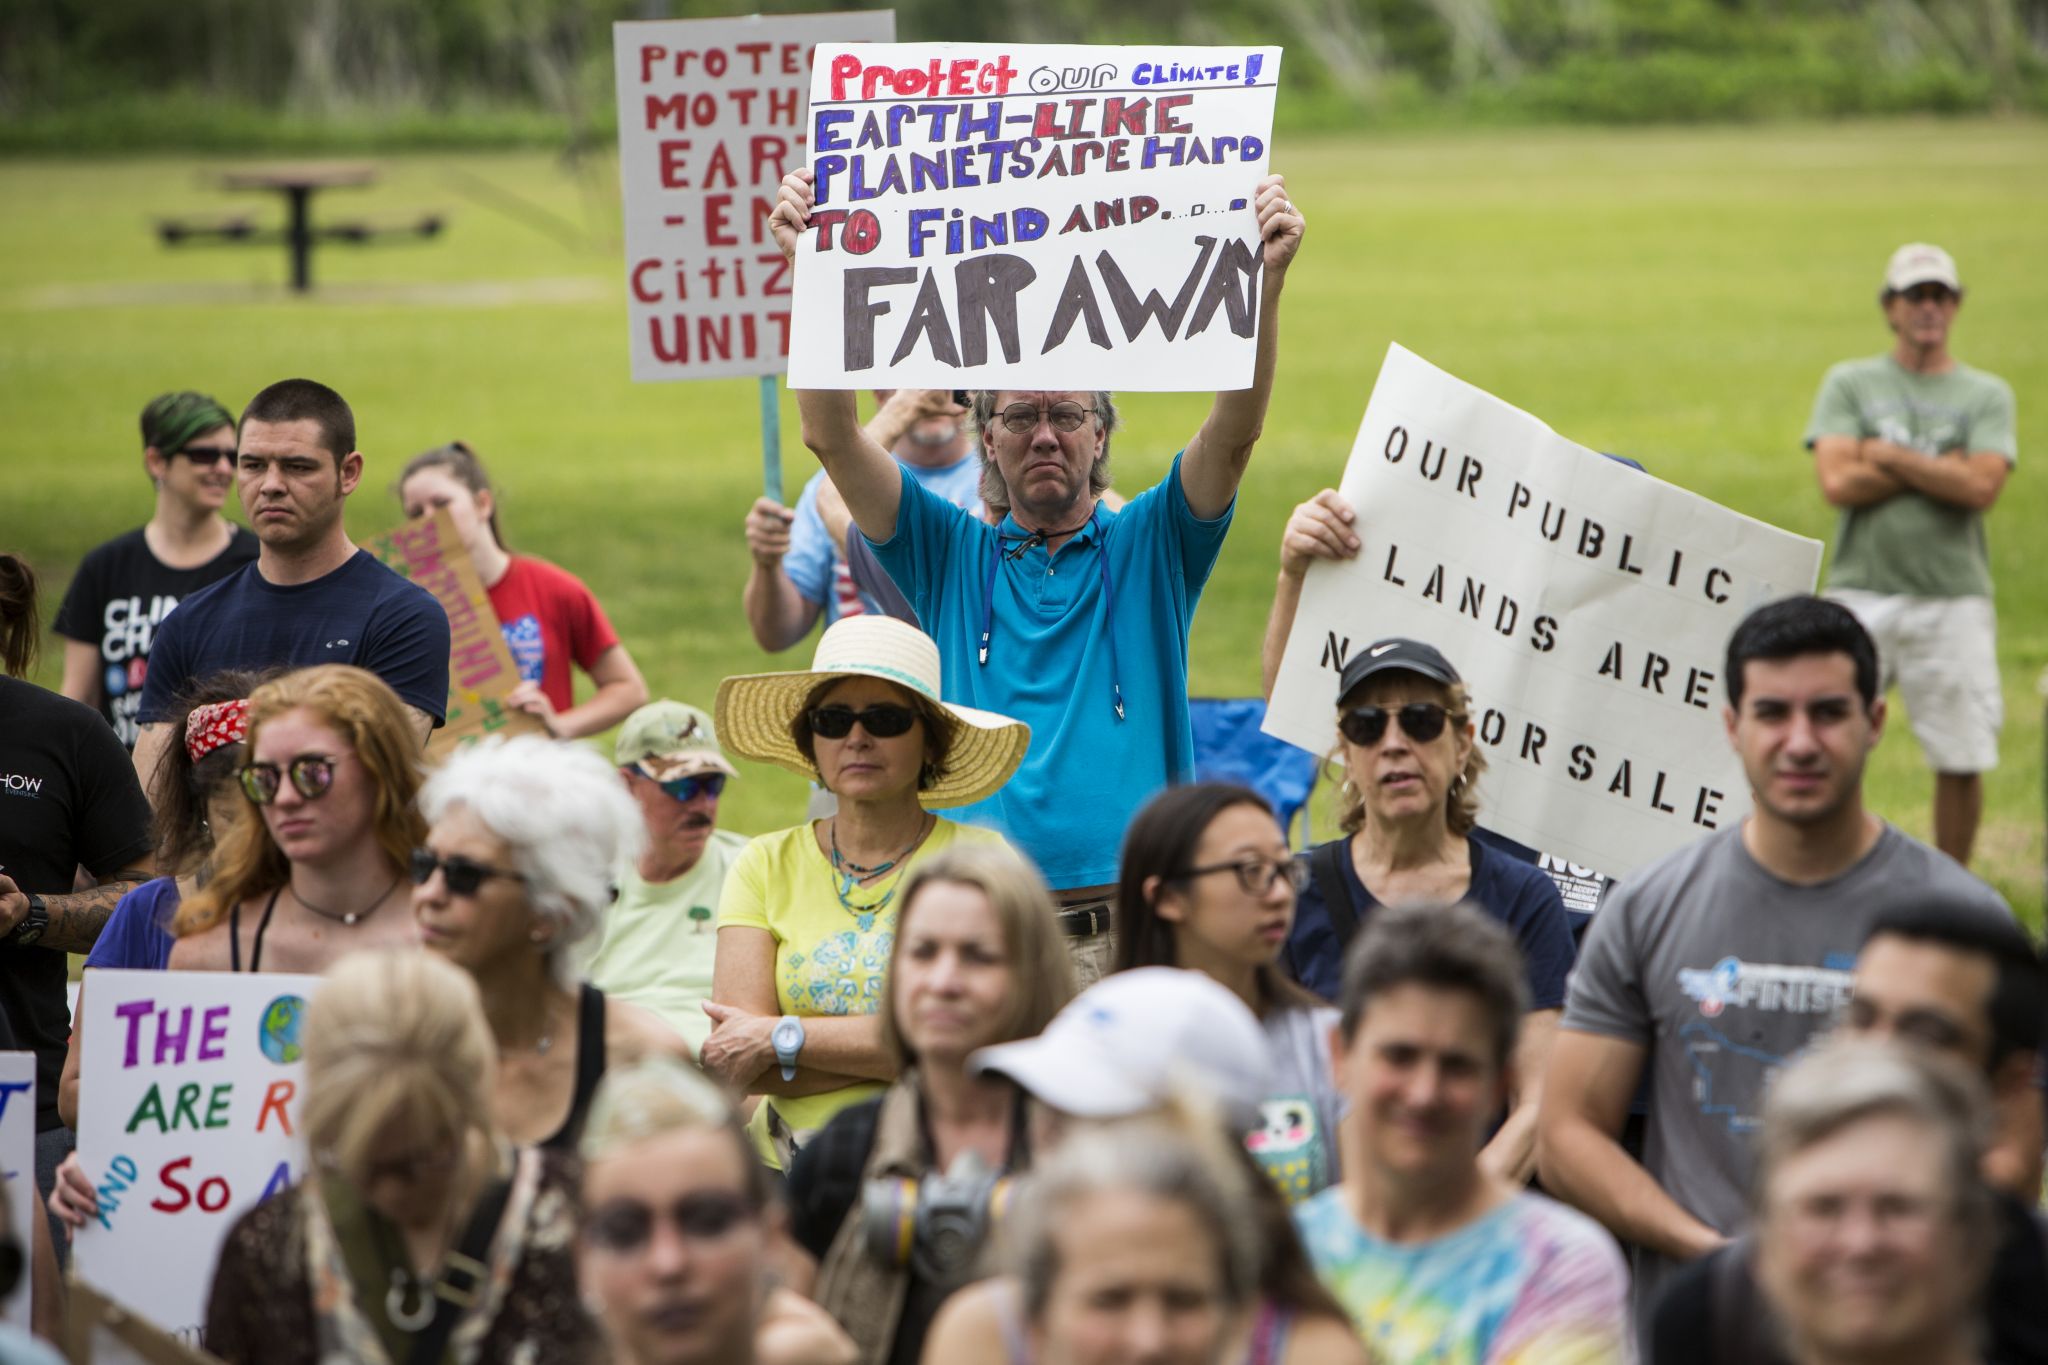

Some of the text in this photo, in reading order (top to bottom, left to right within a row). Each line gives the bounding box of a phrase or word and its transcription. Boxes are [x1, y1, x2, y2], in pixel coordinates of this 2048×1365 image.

[639, 42, 816, 83] ProTE
[831, 54, 1264, 101] ProtEct OUr CLiMATE!
[644, 86, 810, 132] MOTH
[814, 136, 1264, 206] PLANETS ArE HArD
[808, 208, 882, 255] TO
[909, 207, 1050, 258] FiND
[844, 235, 1265, 372] FAR AWAY
[1384, 425, 1733, 604] OUR PUBLIC
[102, 621, 155, 662] CH
[1384, 545, 1715, 709] LANDS ARE
[1480, 708, 1548, 766] OR
[1568, 744, 1725, 830] SALE
[115, 998, 231, 1069] THE
[125, 1081, 234, 1134] ARE
[96, 1154, 139, 1231] AND
[150, 1156, 231, 1214] So
